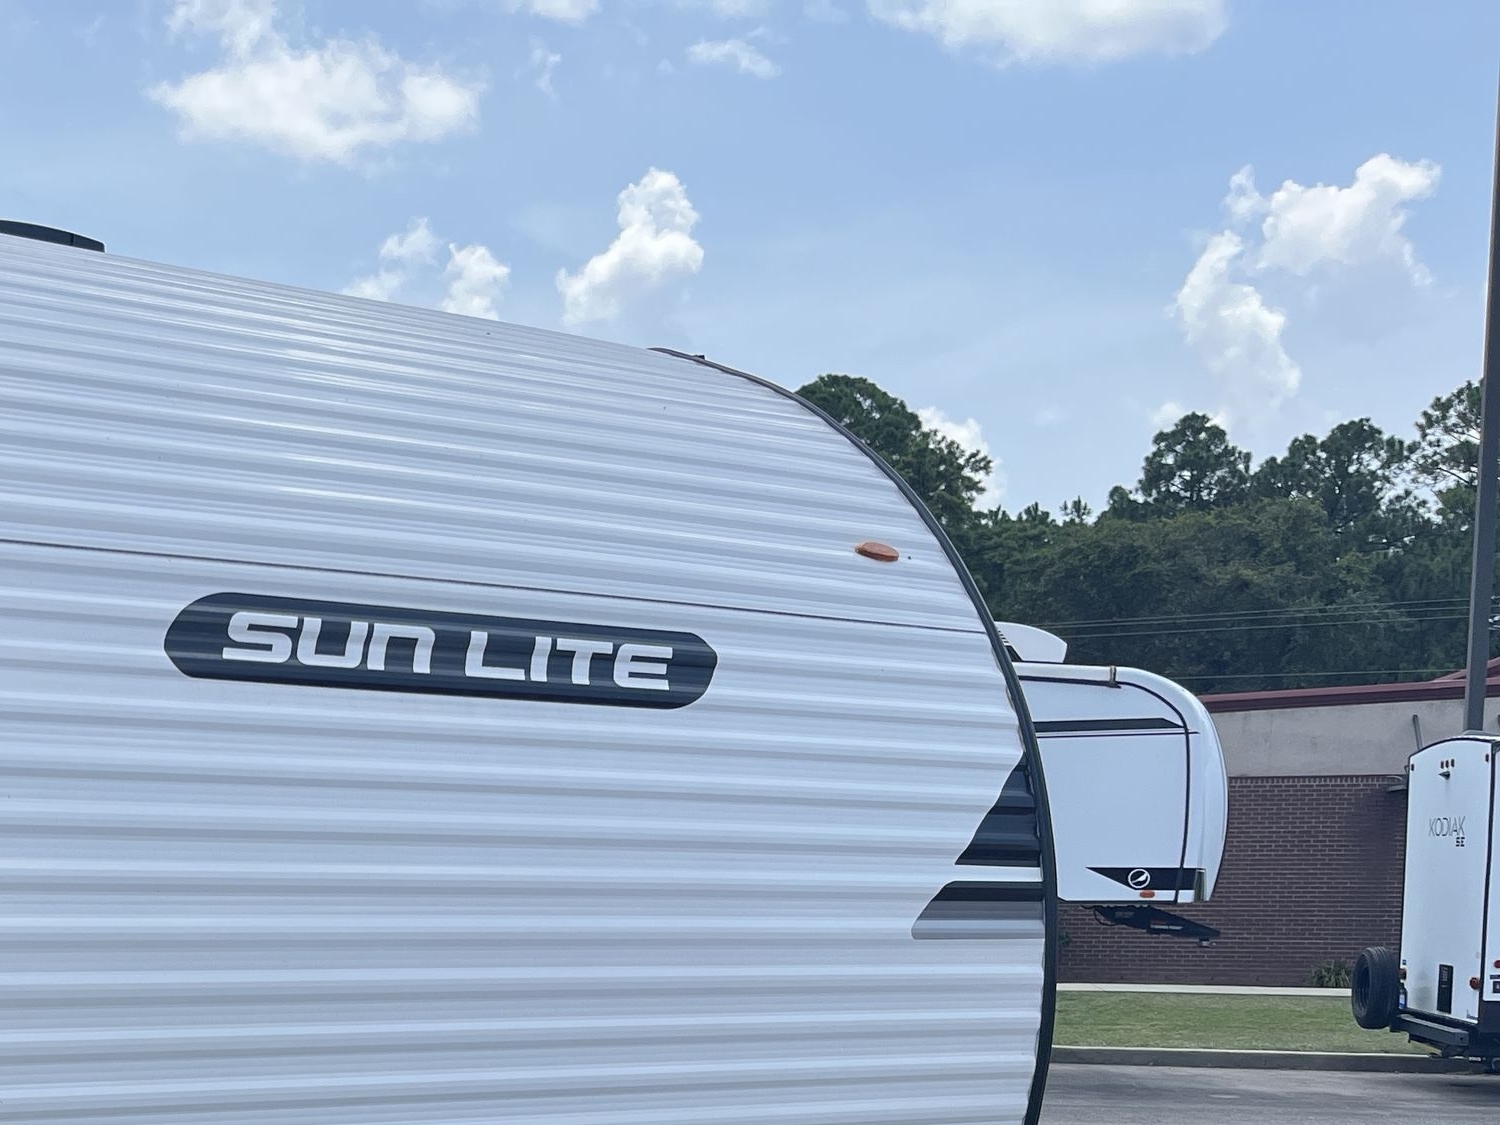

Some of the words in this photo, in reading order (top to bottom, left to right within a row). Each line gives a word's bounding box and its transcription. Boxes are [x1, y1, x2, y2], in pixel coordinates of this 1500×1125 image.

[222, 611, 436, 675] SUN
[465, 631, 674, 691] LITE
[1428, 815, 1466, 837] KODIAK
